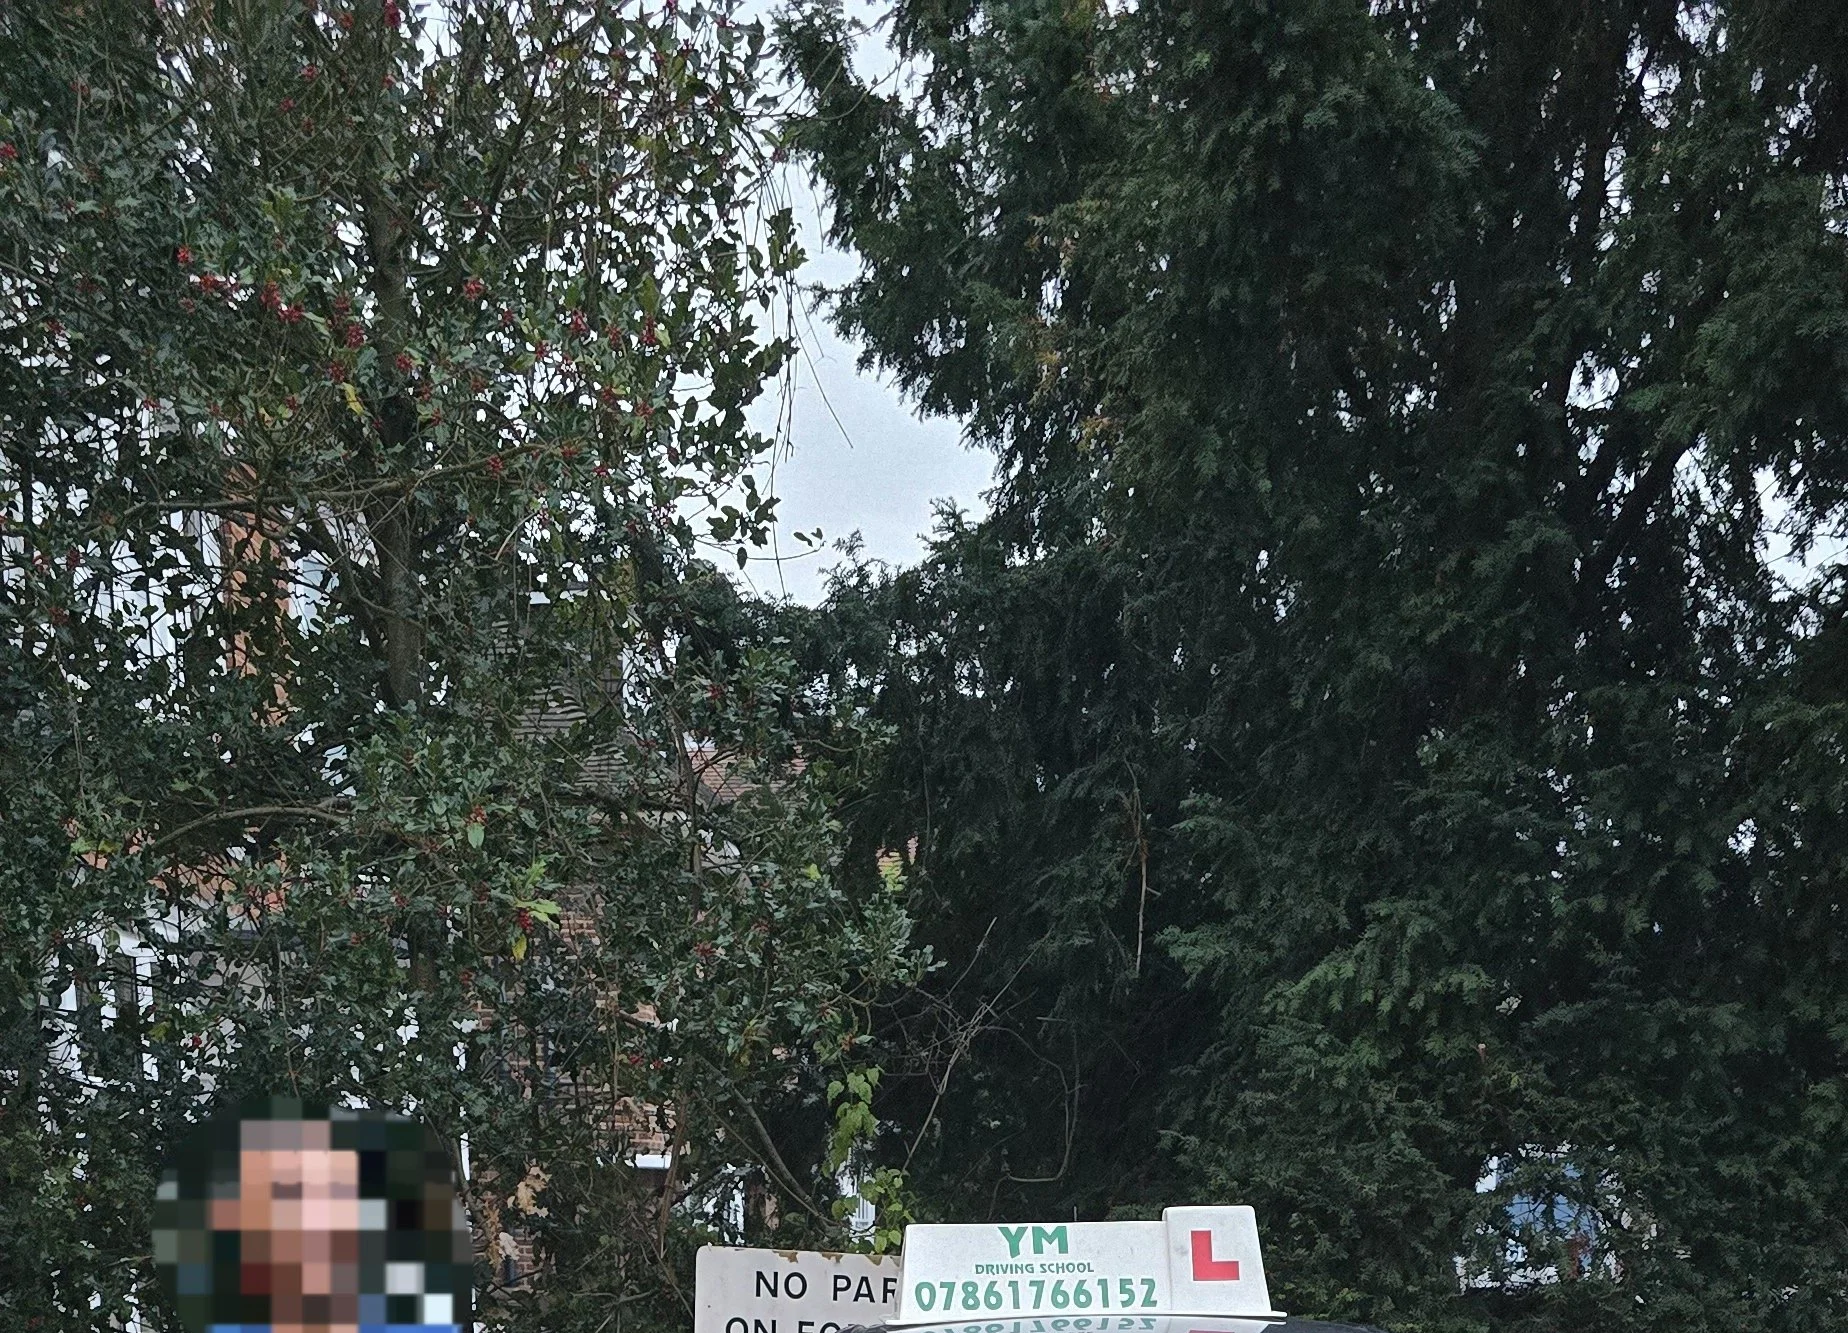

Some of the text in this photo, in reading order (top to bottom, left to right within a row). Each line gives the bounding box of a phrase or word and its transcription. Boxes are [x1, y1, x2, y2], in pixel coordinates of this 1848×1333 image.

[997, 1226, 1069, 1259] YM
[1191, 1230, 1240, 1281] L
[975, 1262, 1094, 1275] DRIVING SCHOOL
[755, 1271, 898, 1304] NO PAR
[915, 1278, 1158, 1312] 07861766152
